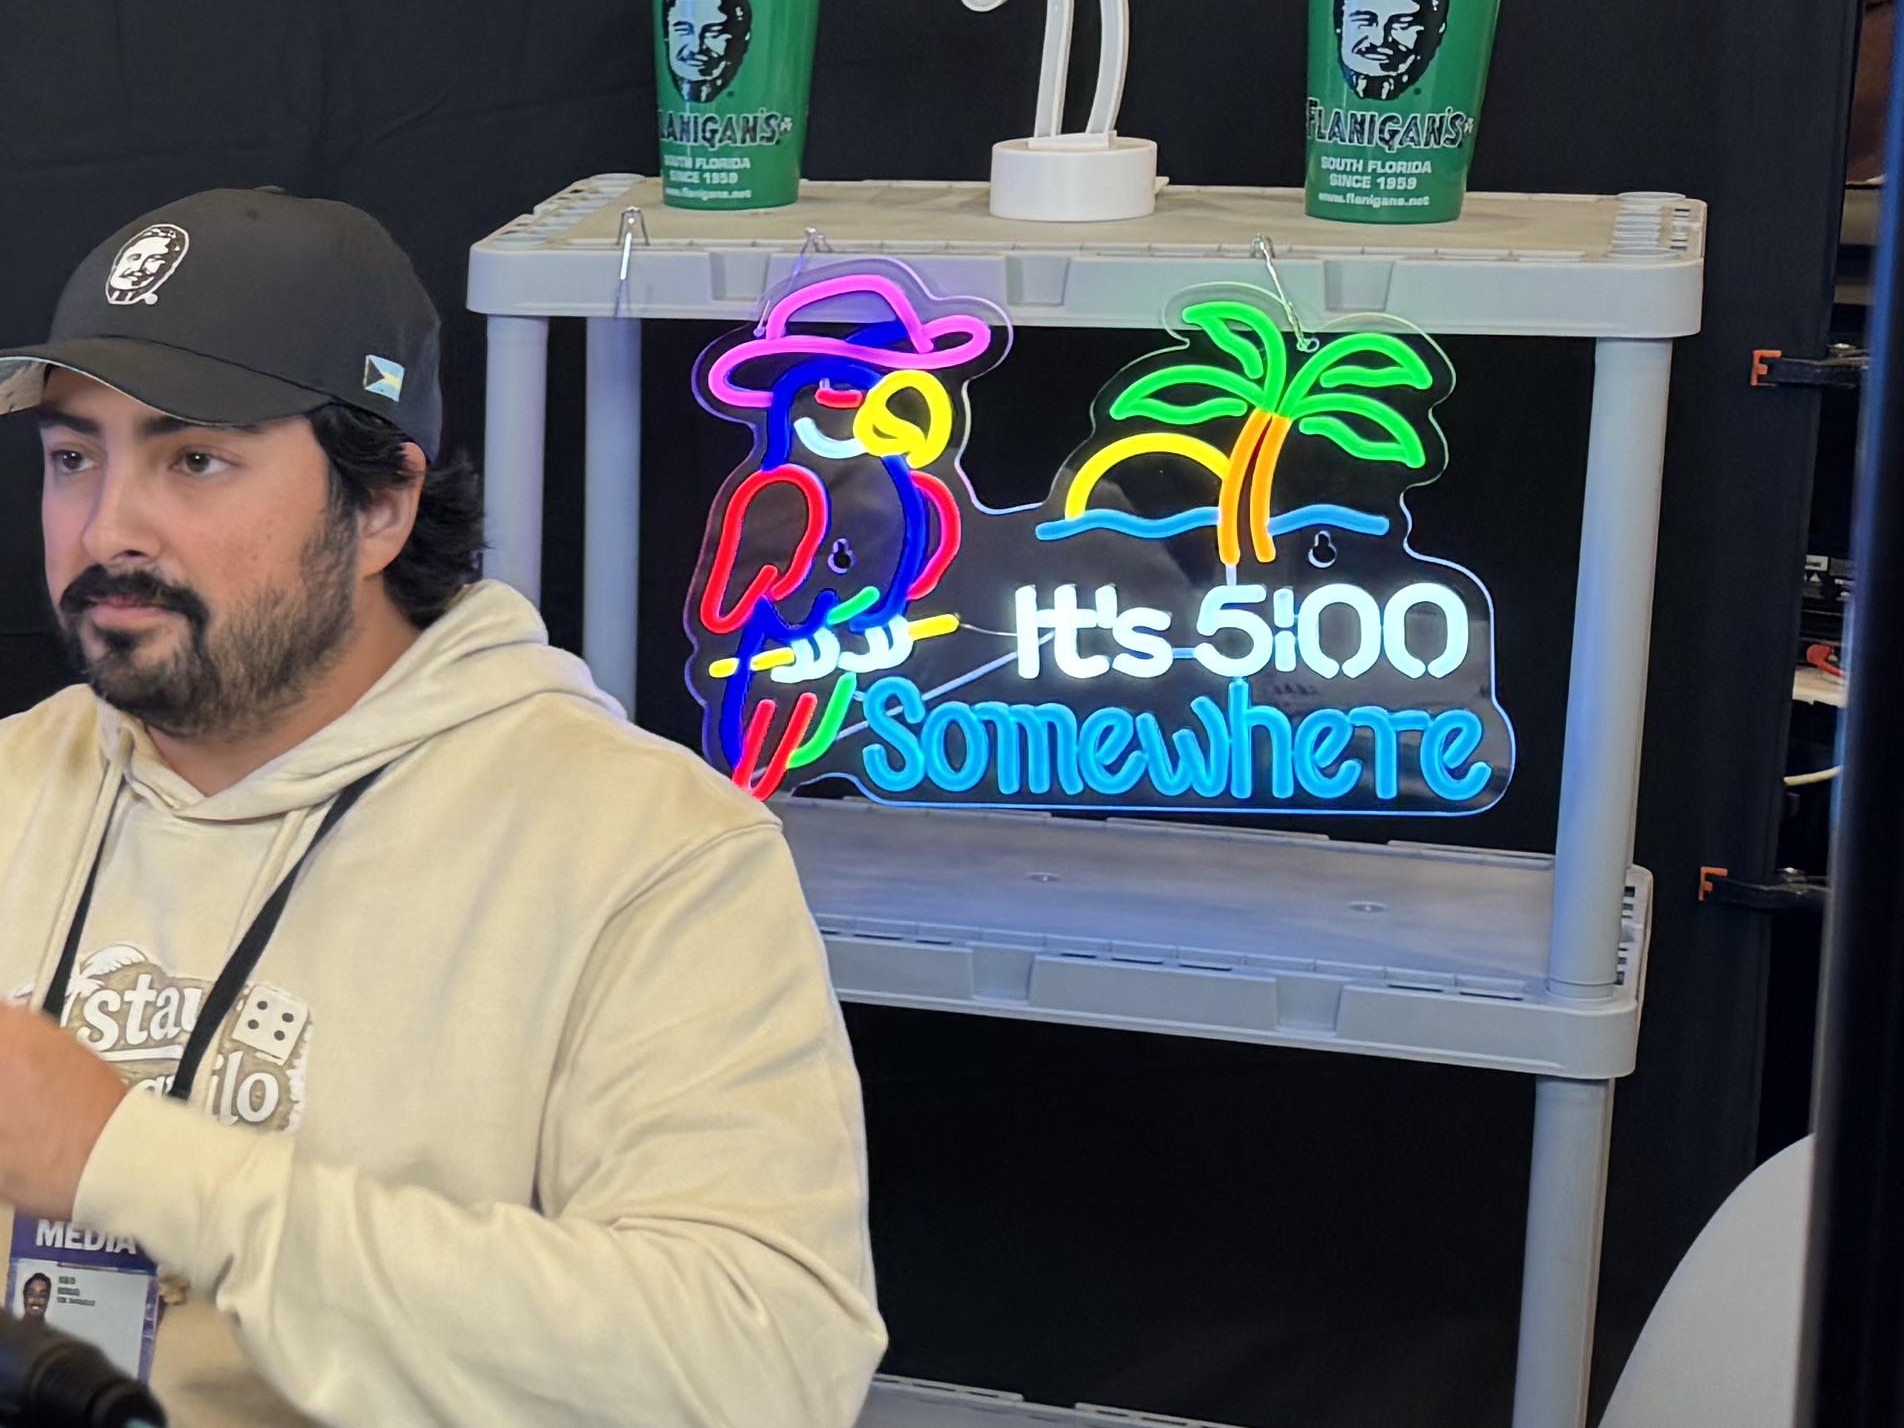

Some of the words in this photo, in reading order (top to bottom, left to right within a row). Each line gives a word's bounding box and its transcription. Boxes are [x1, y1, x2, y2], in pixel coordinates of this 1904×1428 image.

[660, 107, 782, 152] ANIGAN'S
[1307, 97, 1466, 154] FLANIGAN'S
[1321, 156, 1363, 173] SOUTH
[1367, 159, 1432, 174] FLORIDA
[1329, 173, 1371, 189] SINCE
[1376, 176, 1418, 190] 1959
[1013, 582, 1173, 679] It's
[1193, 582, 1469, 679] 5:00
[862, 676, 1492, 800] Somewhere
